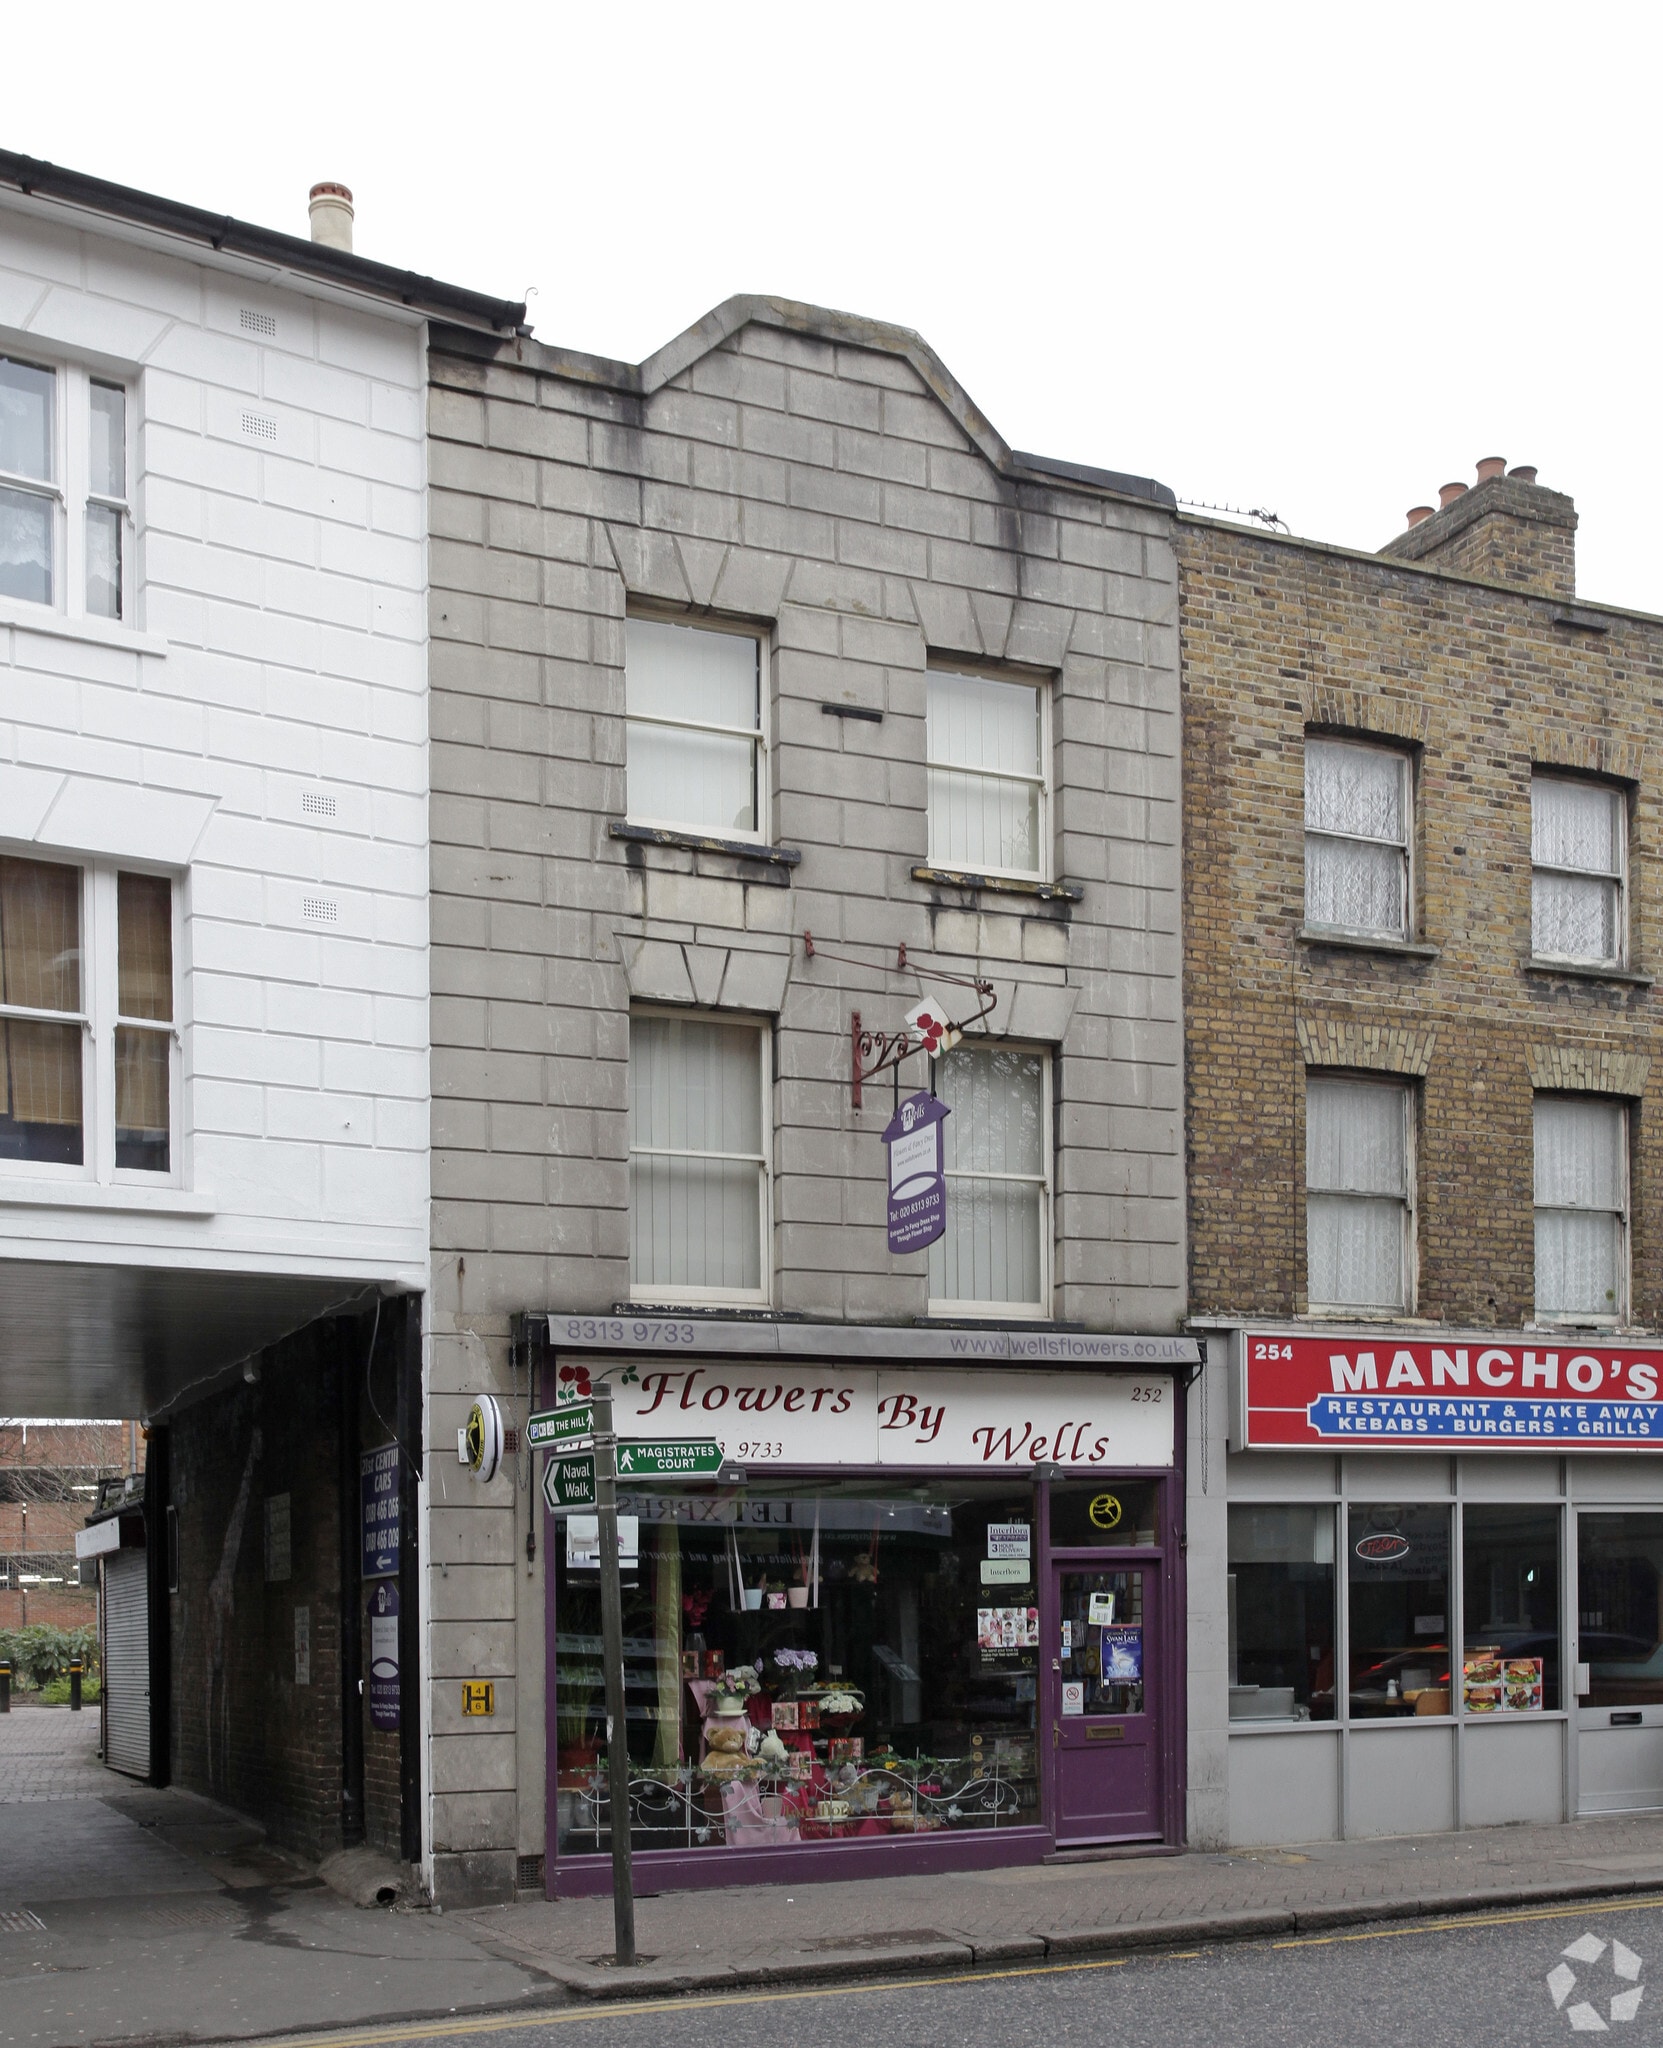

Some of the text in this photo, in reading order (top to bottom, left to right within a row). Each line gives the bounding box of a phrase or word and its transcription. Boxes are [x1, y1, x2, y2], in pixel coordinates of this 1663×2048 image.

[900, 1205, 910, 1218] 020
[911, 1199, 925, 1214] 8313
[926, 1193, 940, 1208] 9733
[567, 1319, 695, 1343] 8313 9733
[950, 1335, 1187, 1358] wwwwellsflowers.co.uk
[1255, 1343, 1293, 1361] 254
[1329, 1348, 1659, 1400] MANCHO'S
[1131, 1387, 1162, 1403] 252
[636, 1368, 1110, 1462] Flowers By Wells
[1328, 1400, 1658, 1420] RESTAURANT & TAKE AWAY
[555, 1419, 569, 1431] THE
[570, 1416, 586, 1429] HILL
[1338, 1417, 1428, 1431] KEBABS
[1453, 1419, 1555, 1433] BURGERS
[1577, 1421, 1650, 1435] GRILLS
[637, 1446, 715, 1458] MAGISTRATES
[737, 1441, 783, 1458] 9733
[562, 1462, 590, 1480] Naval
[657, 1458, 696, 1470] COURT
[374, 1471, 392, 1493] CARS
[565, 1482, 590, 1498] Walk
[990, 1526, 1028, 1535] Interflora
[991, 1543, 998, 1553] 3
[990, 1568, 1021, 1576] Interflora
[1106, 1634, 1123, 1644] SWAN
[466, 1685, 490, 1712] H
[476, 1687, 481, 1695] 4
